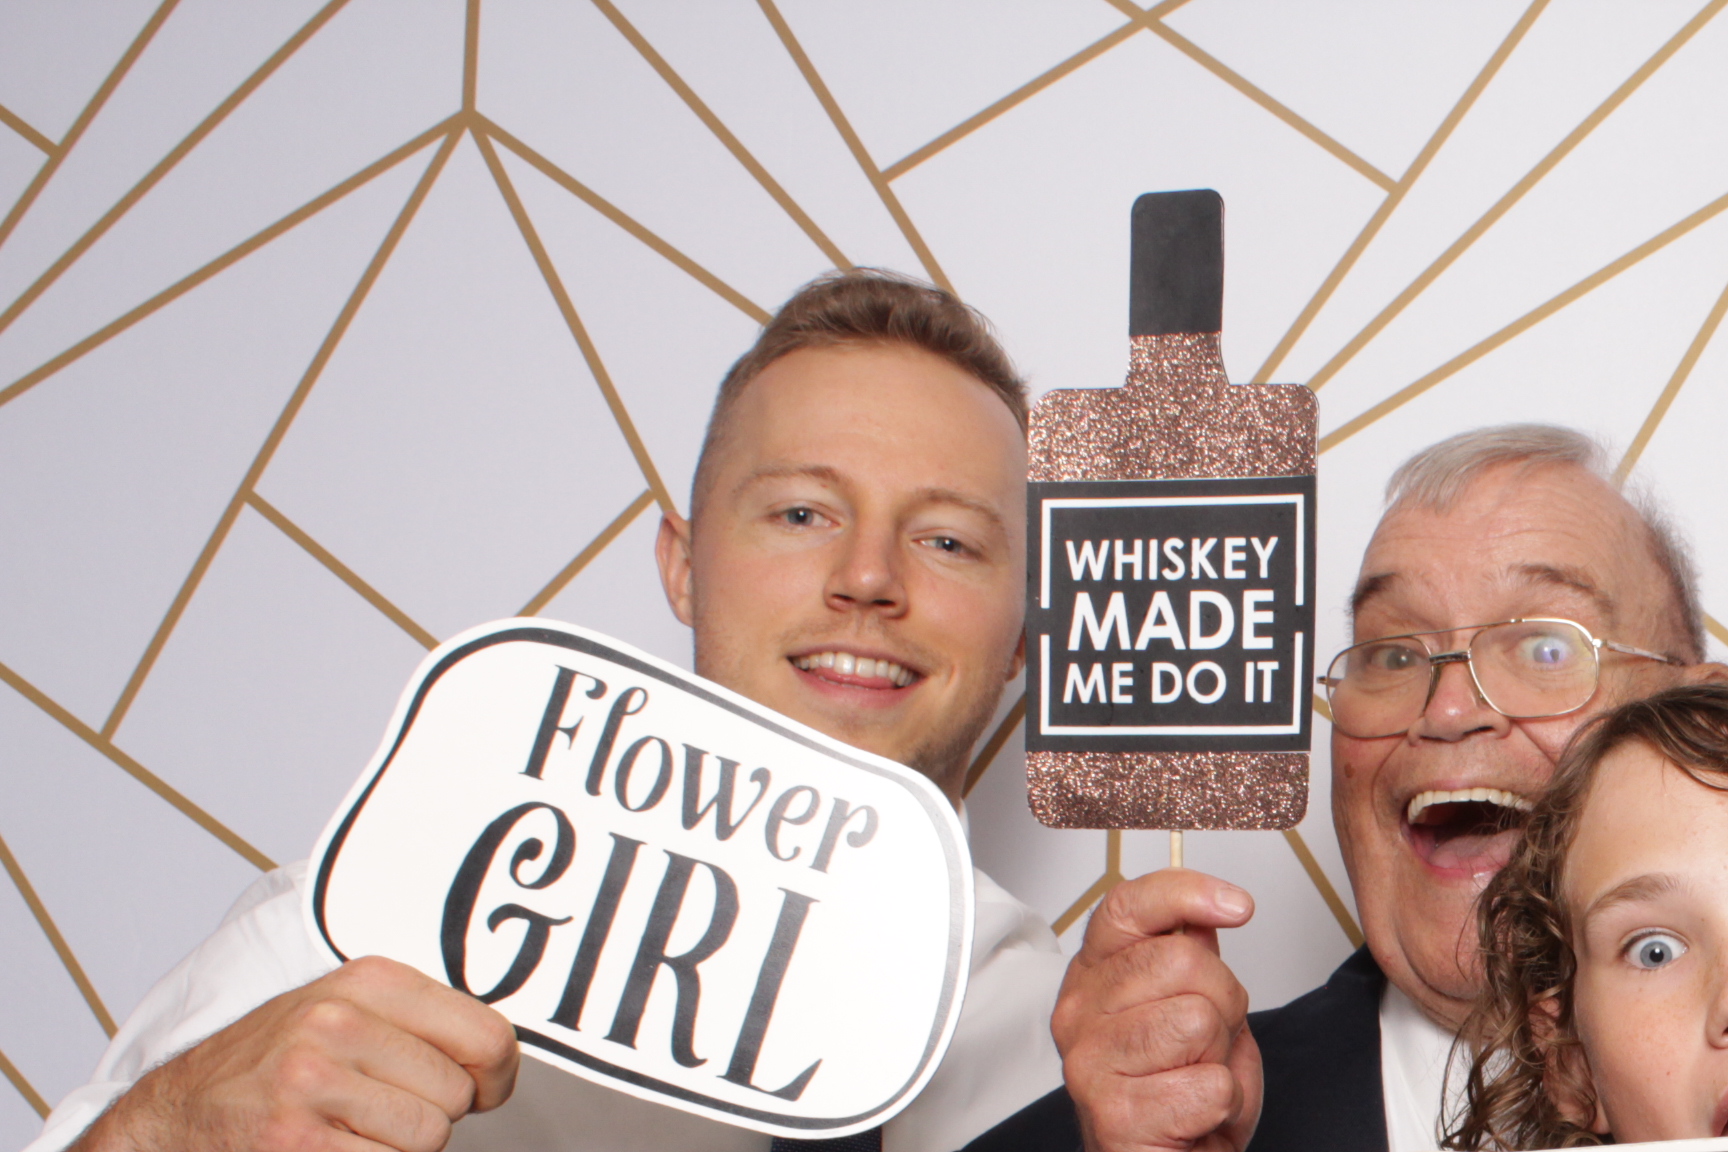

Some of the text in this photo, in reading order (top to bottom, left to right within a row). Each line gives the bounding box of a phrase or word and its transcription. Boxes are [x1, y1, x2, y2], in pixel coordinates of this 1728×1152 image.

[1065, 536, 1278, 581] WHISKEY
[1067, 590, 1274, 651] MADE
[1063, 661, 1279, 704] ME DO IT
[518, 664, 879, 875] Flower
[439, 801, 823, 1102] GIRL
